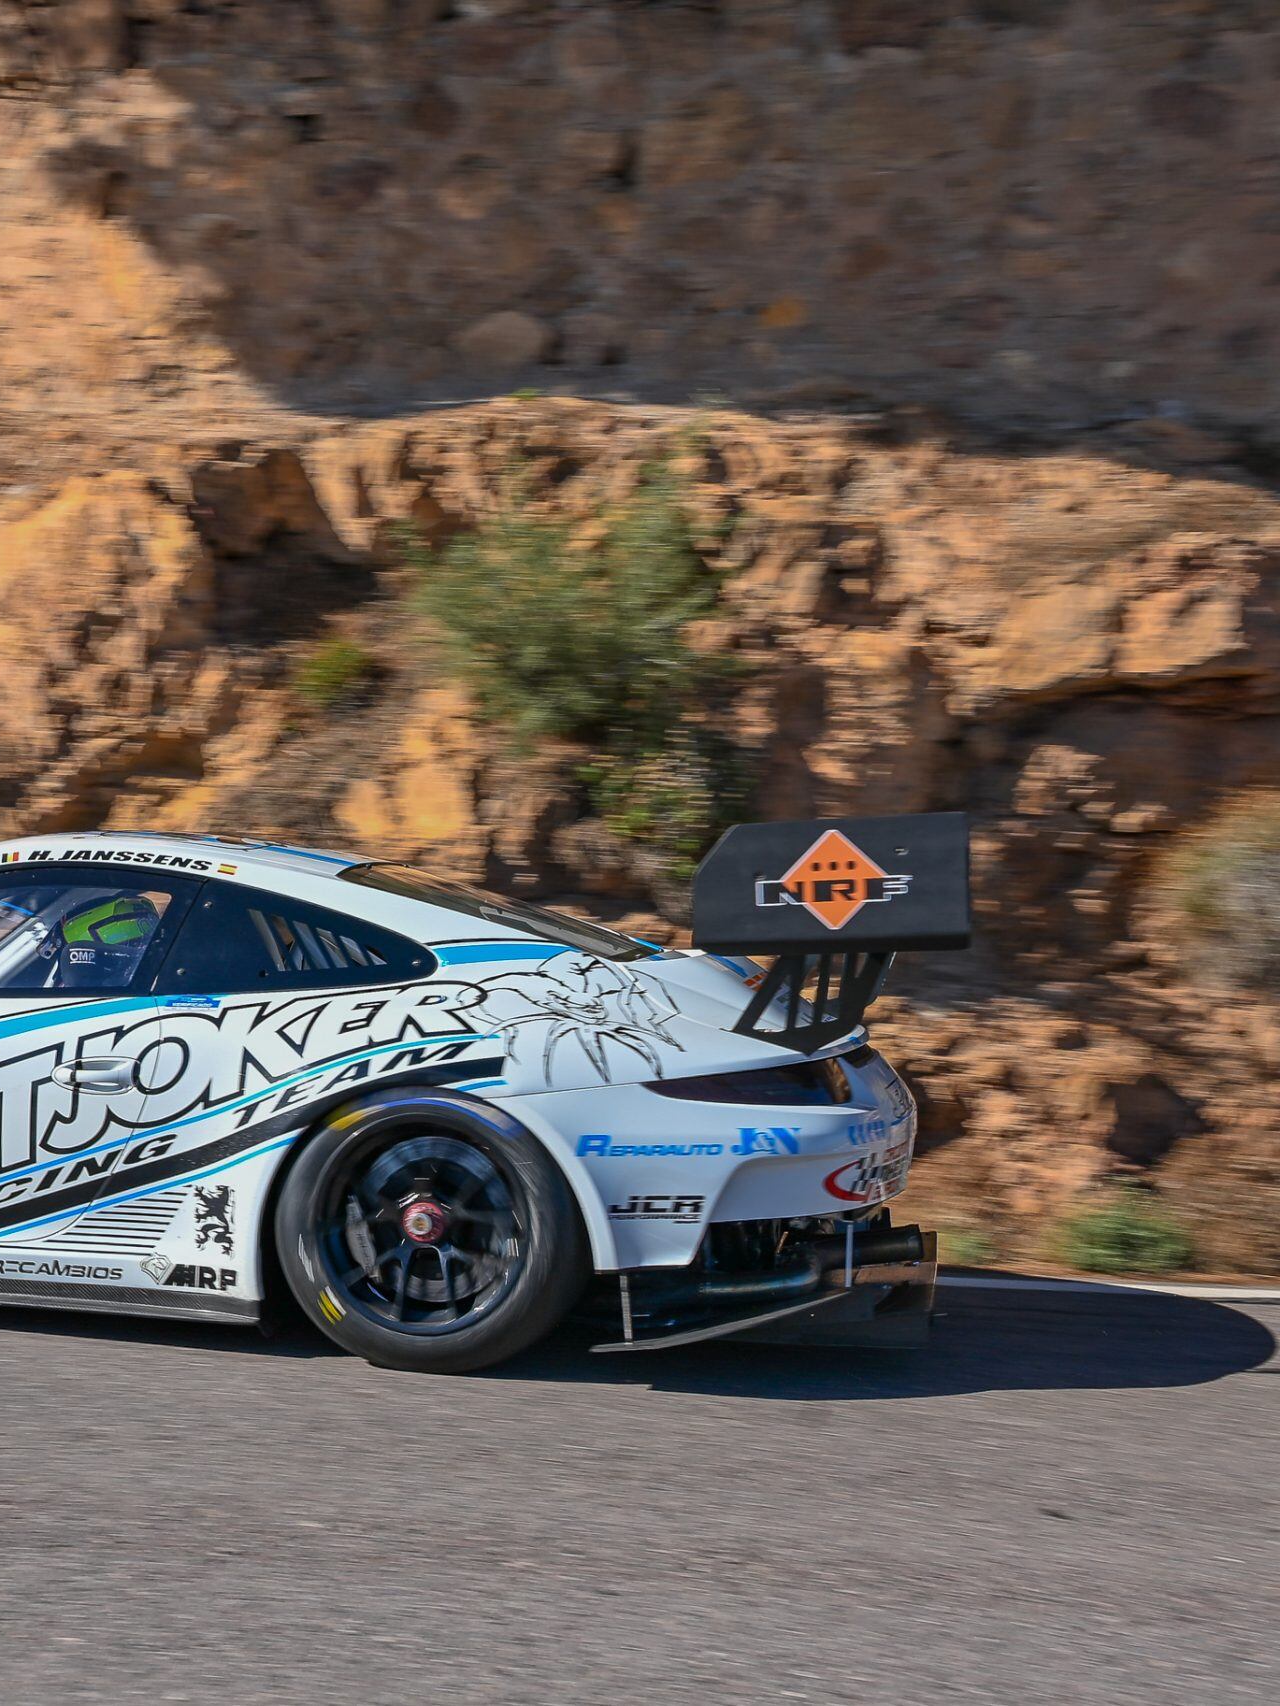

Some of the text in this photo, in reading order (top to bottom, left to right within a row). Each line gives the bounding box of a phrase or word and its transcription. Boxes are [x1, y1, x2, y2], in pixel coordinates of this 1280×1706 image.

[755, 874, 914, 907] NRF
[69, 950, 96, 963] OMP
[234, 1040, 482, 1129] TEAM
[608, 1195, 706, 1213] JCR
